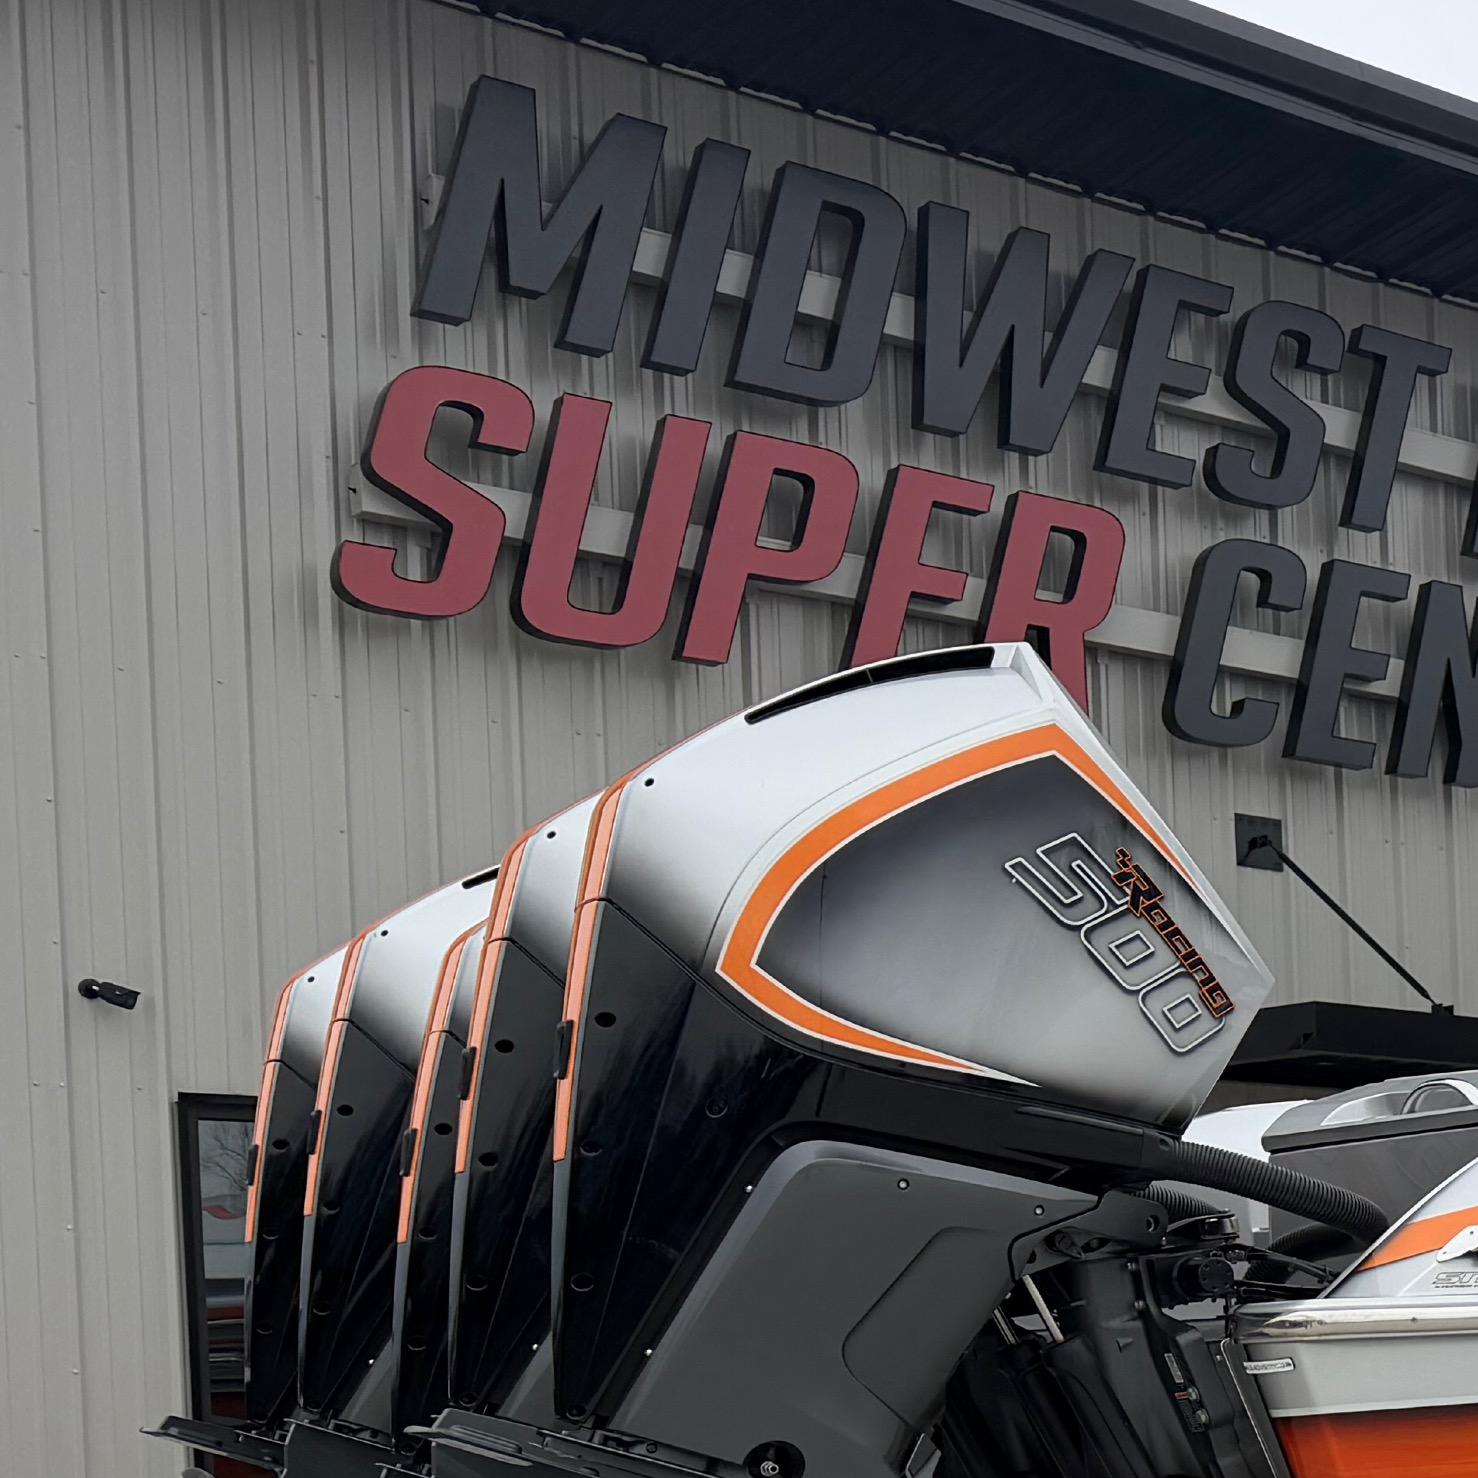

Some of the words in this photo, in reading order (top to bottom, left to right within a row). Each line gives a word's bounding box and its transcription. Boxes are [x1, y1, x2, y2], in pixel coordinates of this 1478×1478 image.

[411, 74, 1453, 533] MIDWEST
[331, 365, 1127, 718] SUPER
[1004, 832, 1226, 1053] 500
